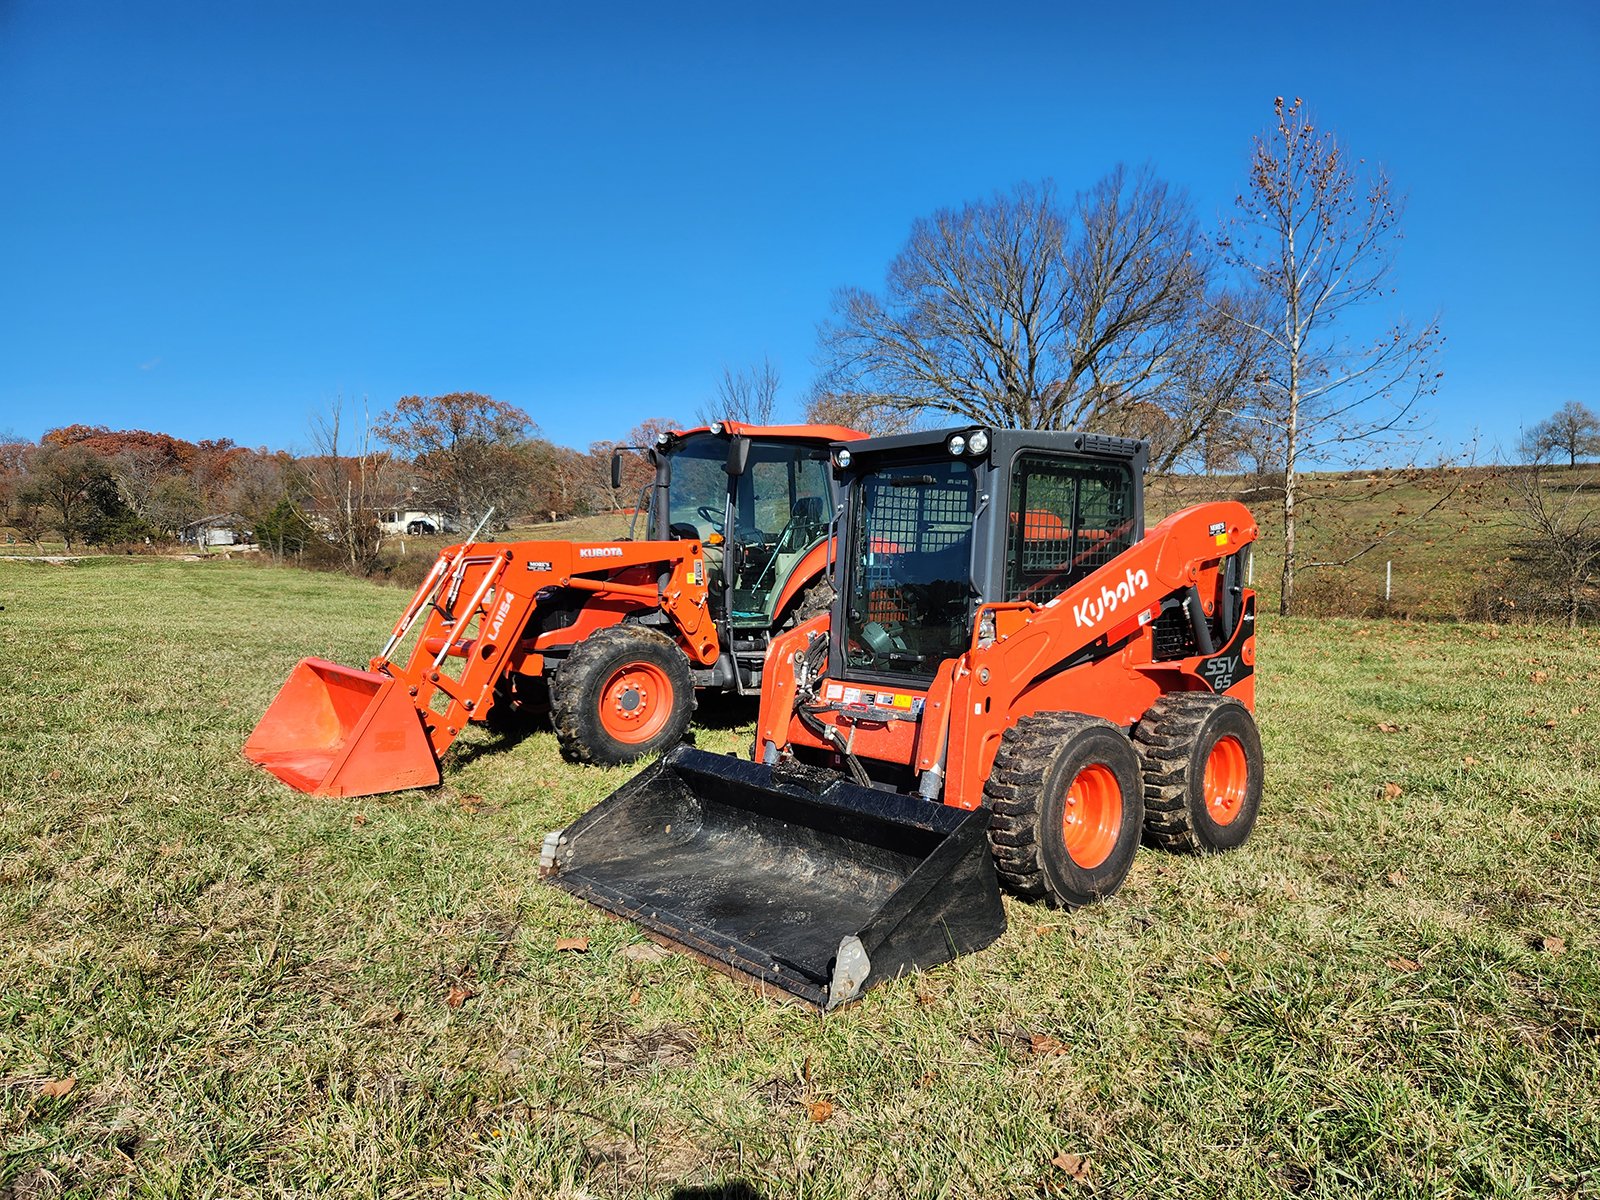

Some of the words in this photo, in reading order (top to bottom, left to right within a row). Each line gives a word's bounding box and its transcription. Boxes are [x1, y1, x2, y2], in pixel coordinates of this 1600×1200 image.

[580, 547, 623, 558] KUBOTA
[1073, 568, 1149, 628] Kubota
[487, 591, 515, 641] LA1154
[1204, 655, 1239, 676] SSV
[1214, 674, 1233, 690] 65
